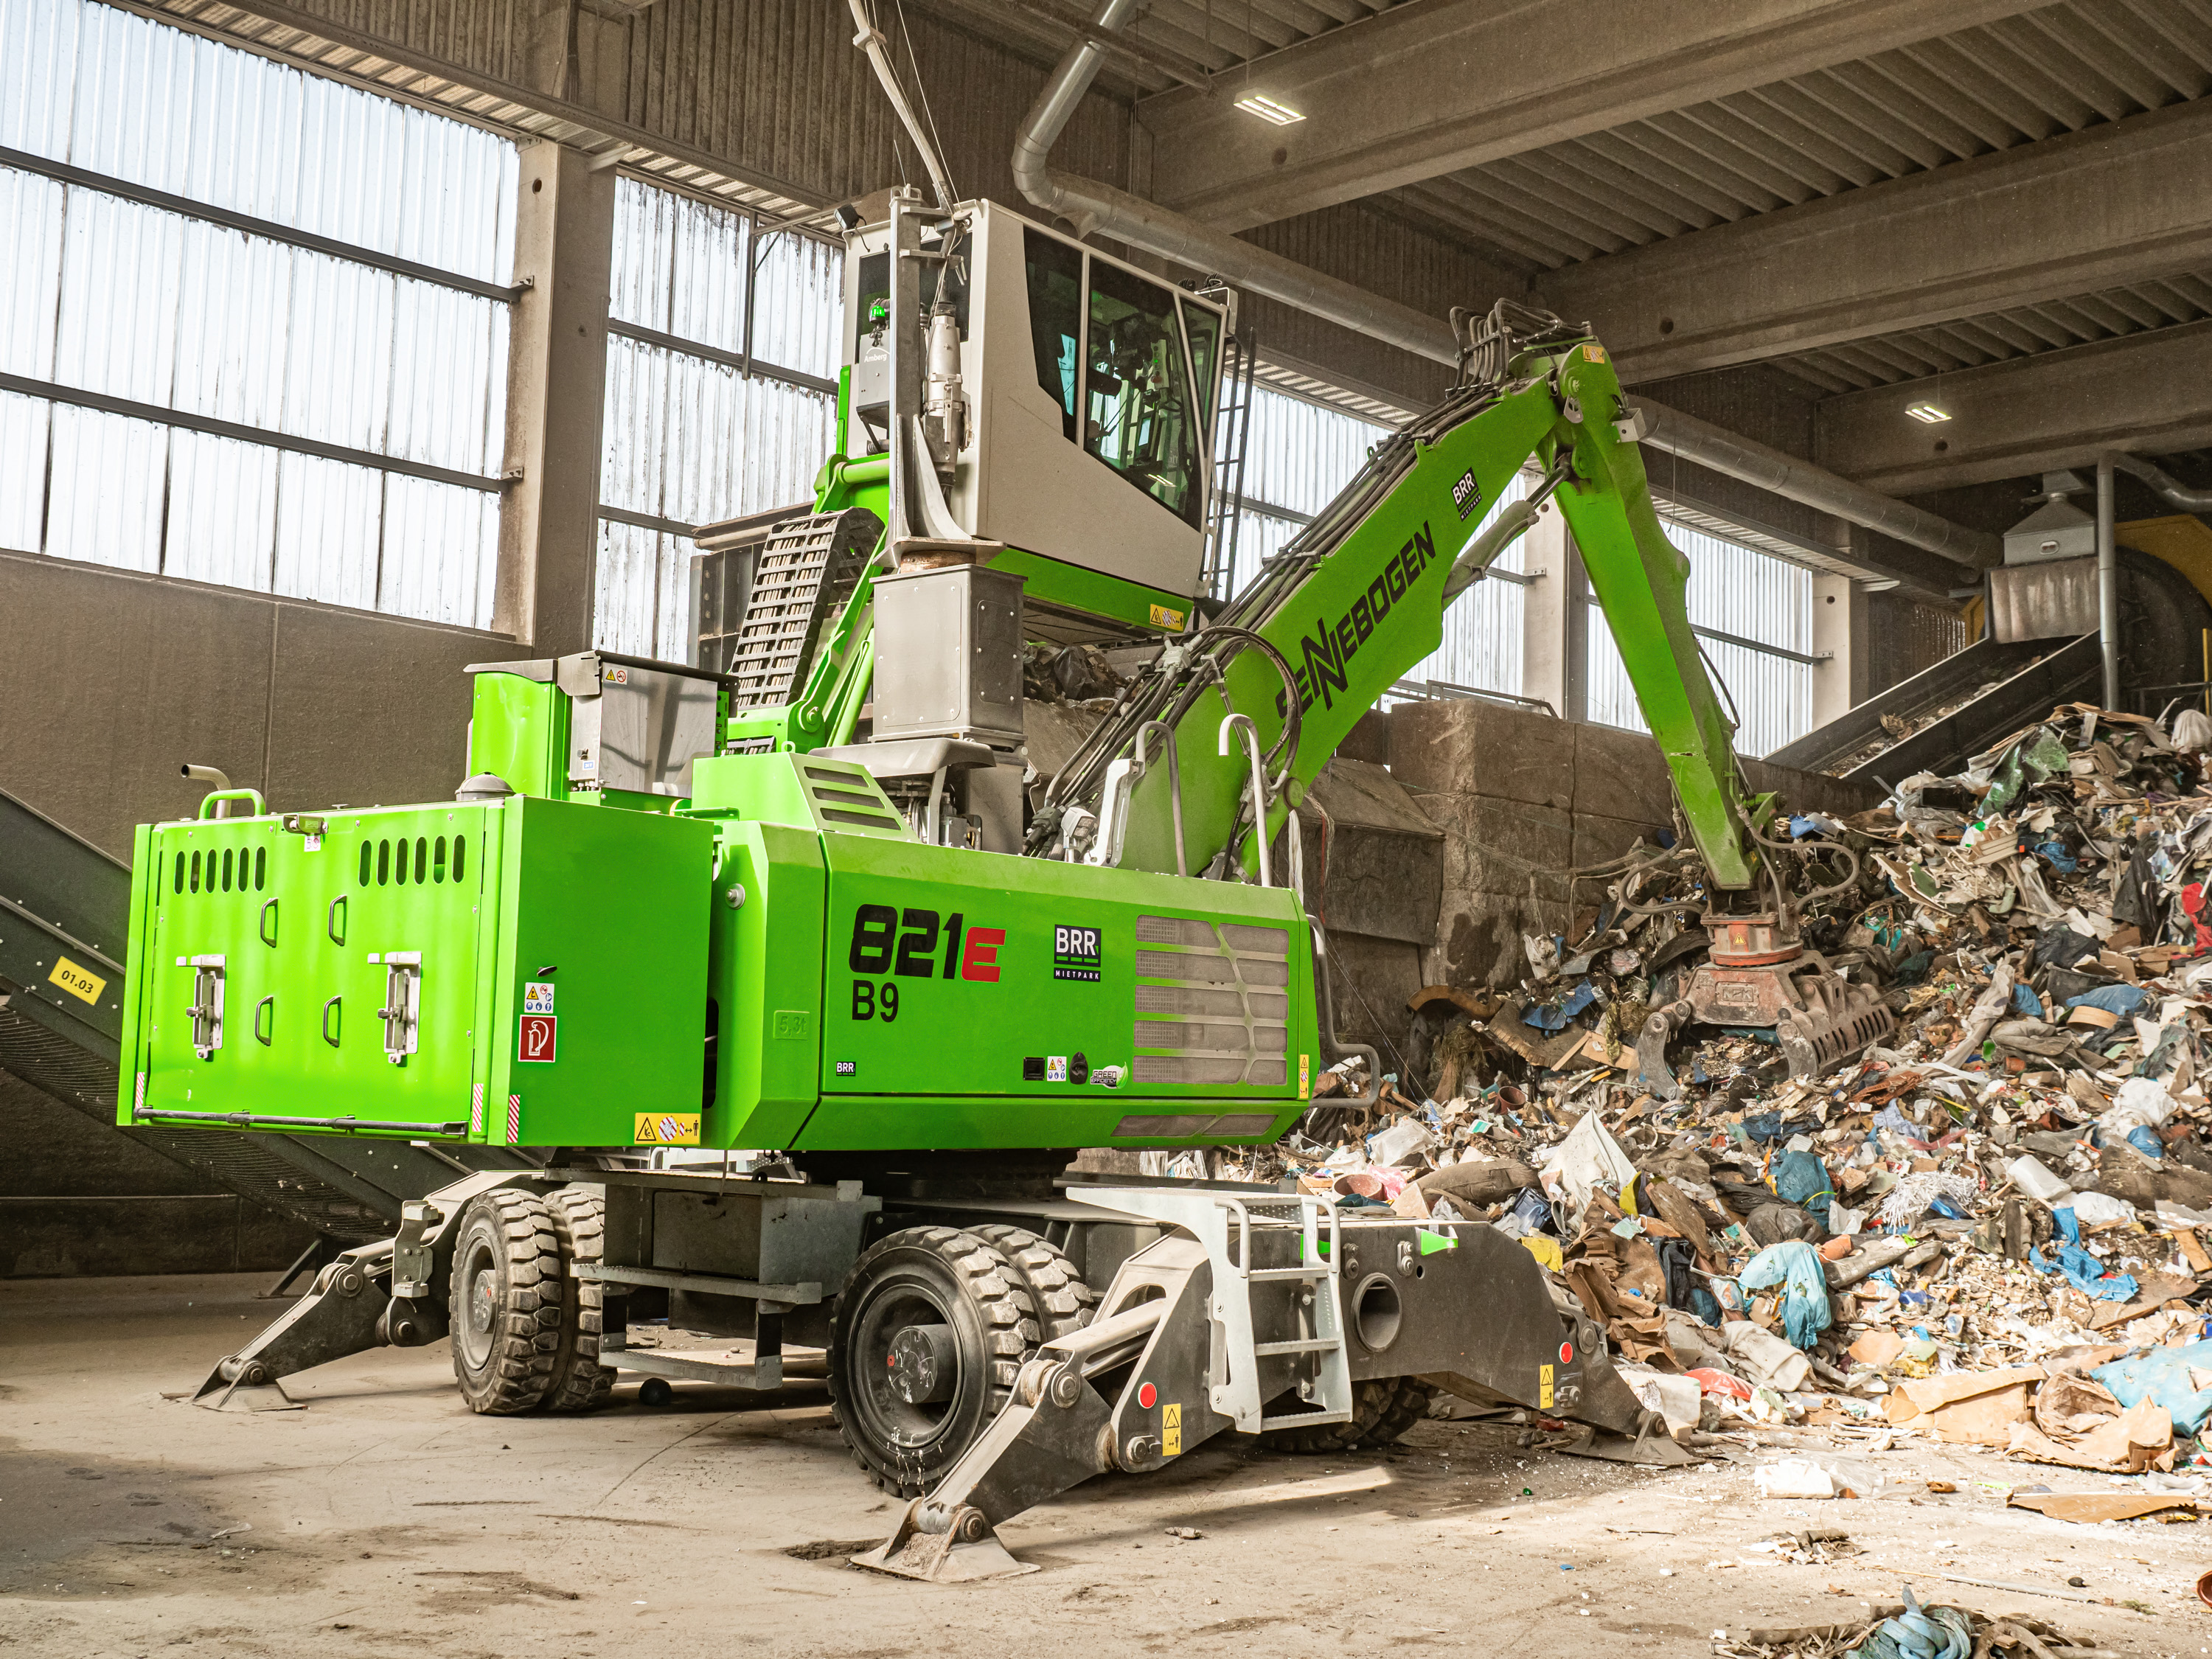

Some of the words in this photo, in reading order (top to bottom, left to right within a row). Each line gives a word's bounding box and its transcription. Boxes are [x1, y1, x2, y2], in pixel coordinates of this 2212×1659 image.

[863, 354, 887, 363] Amberg
[1452, 473, 1475, 505] BRR
[1461, 495, 1481, 519] MIETPARK
[849, 903, 1006, 983] 821E
[1056, 928, 1096, 956] BRR
[61, 970, 94, 994] 01.03
[1055, 970, 1099, 980] MIETPARK
[852, 979, 899, 1023] B9
[1722, 988, 1752, 1000] NPK
[836, 1062, 854, 1073] BRR
